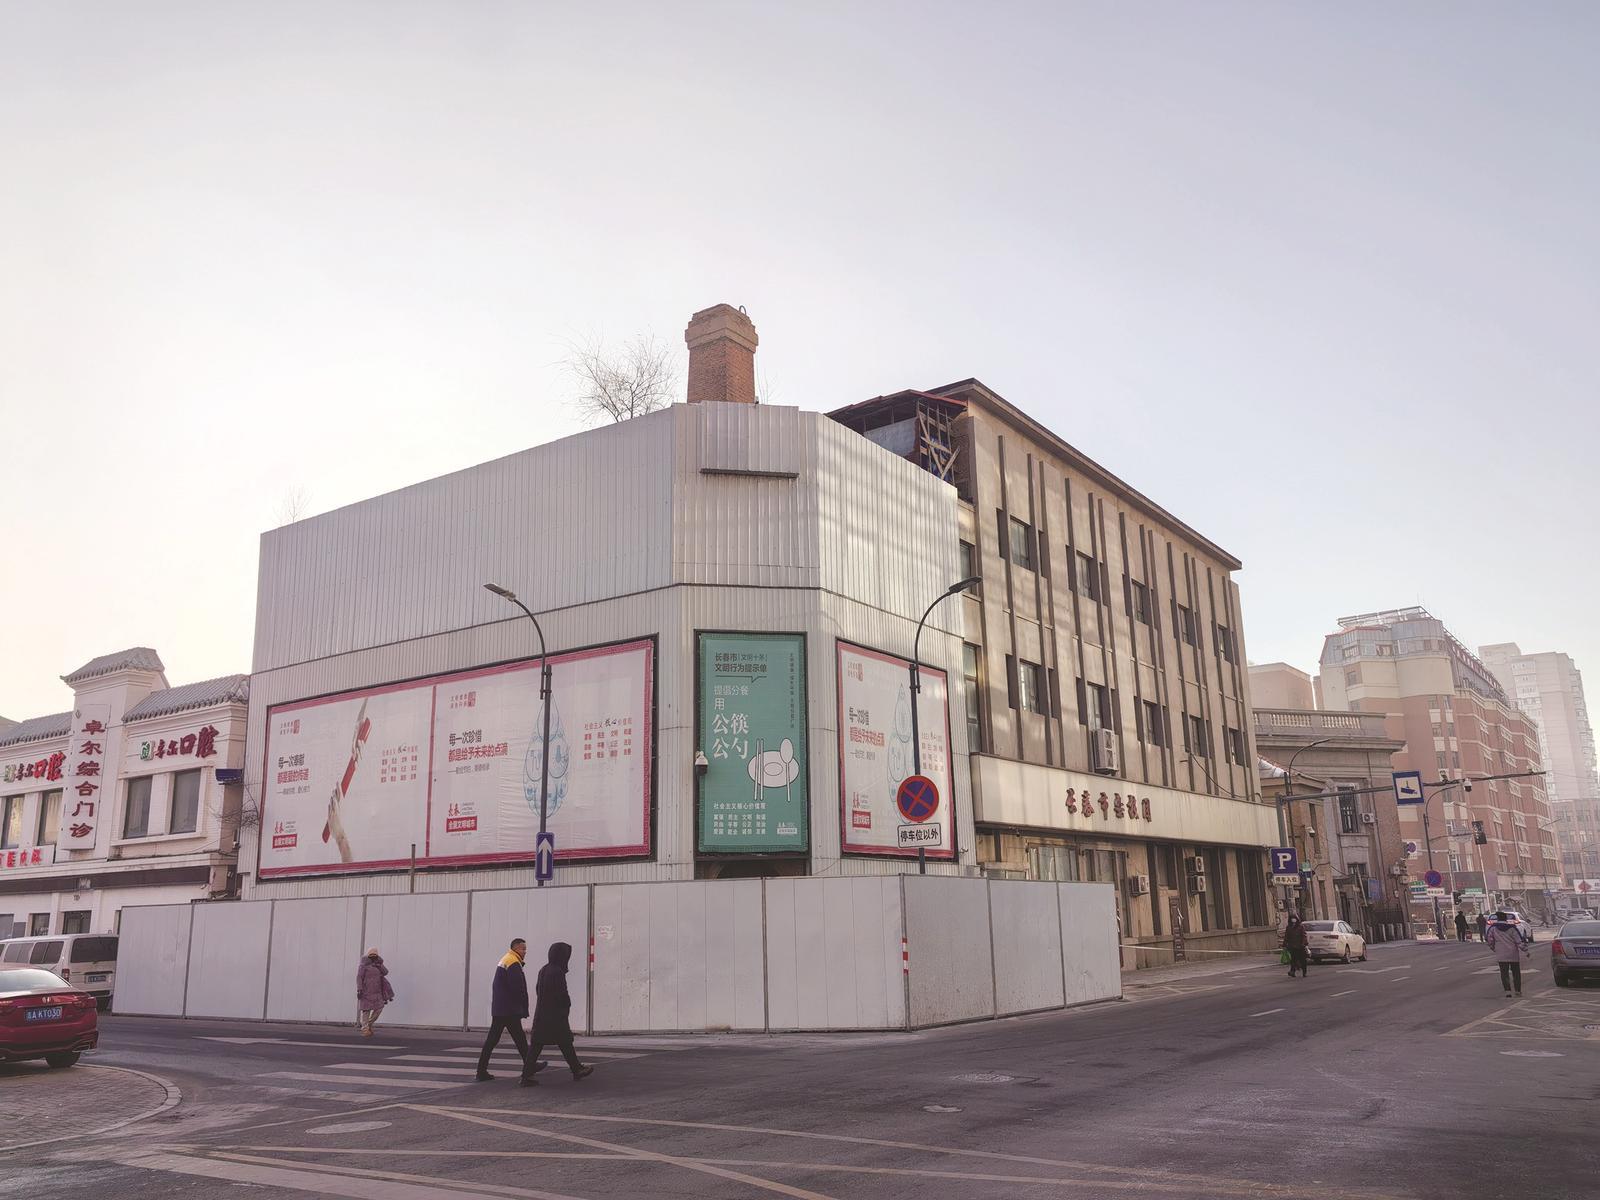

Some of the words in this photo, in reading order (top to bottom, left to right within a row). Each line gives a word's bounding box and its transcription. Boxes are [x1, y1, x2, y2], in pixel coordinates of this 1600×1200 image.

[714, 697, 725, 710] 用
[711, 712, 749, 736] 公筷
[449, 729, 482, 747] 每一次珍惜
[448, 742, 508, 762] 都是给予未来的点滴
[711, 736, 749, 760] 公勺
[69, 719, 106, 838] 卓尔综合门诊
[900, 829, 939, 842] 停车位以外
[1276, 852, 1292, 870] P
